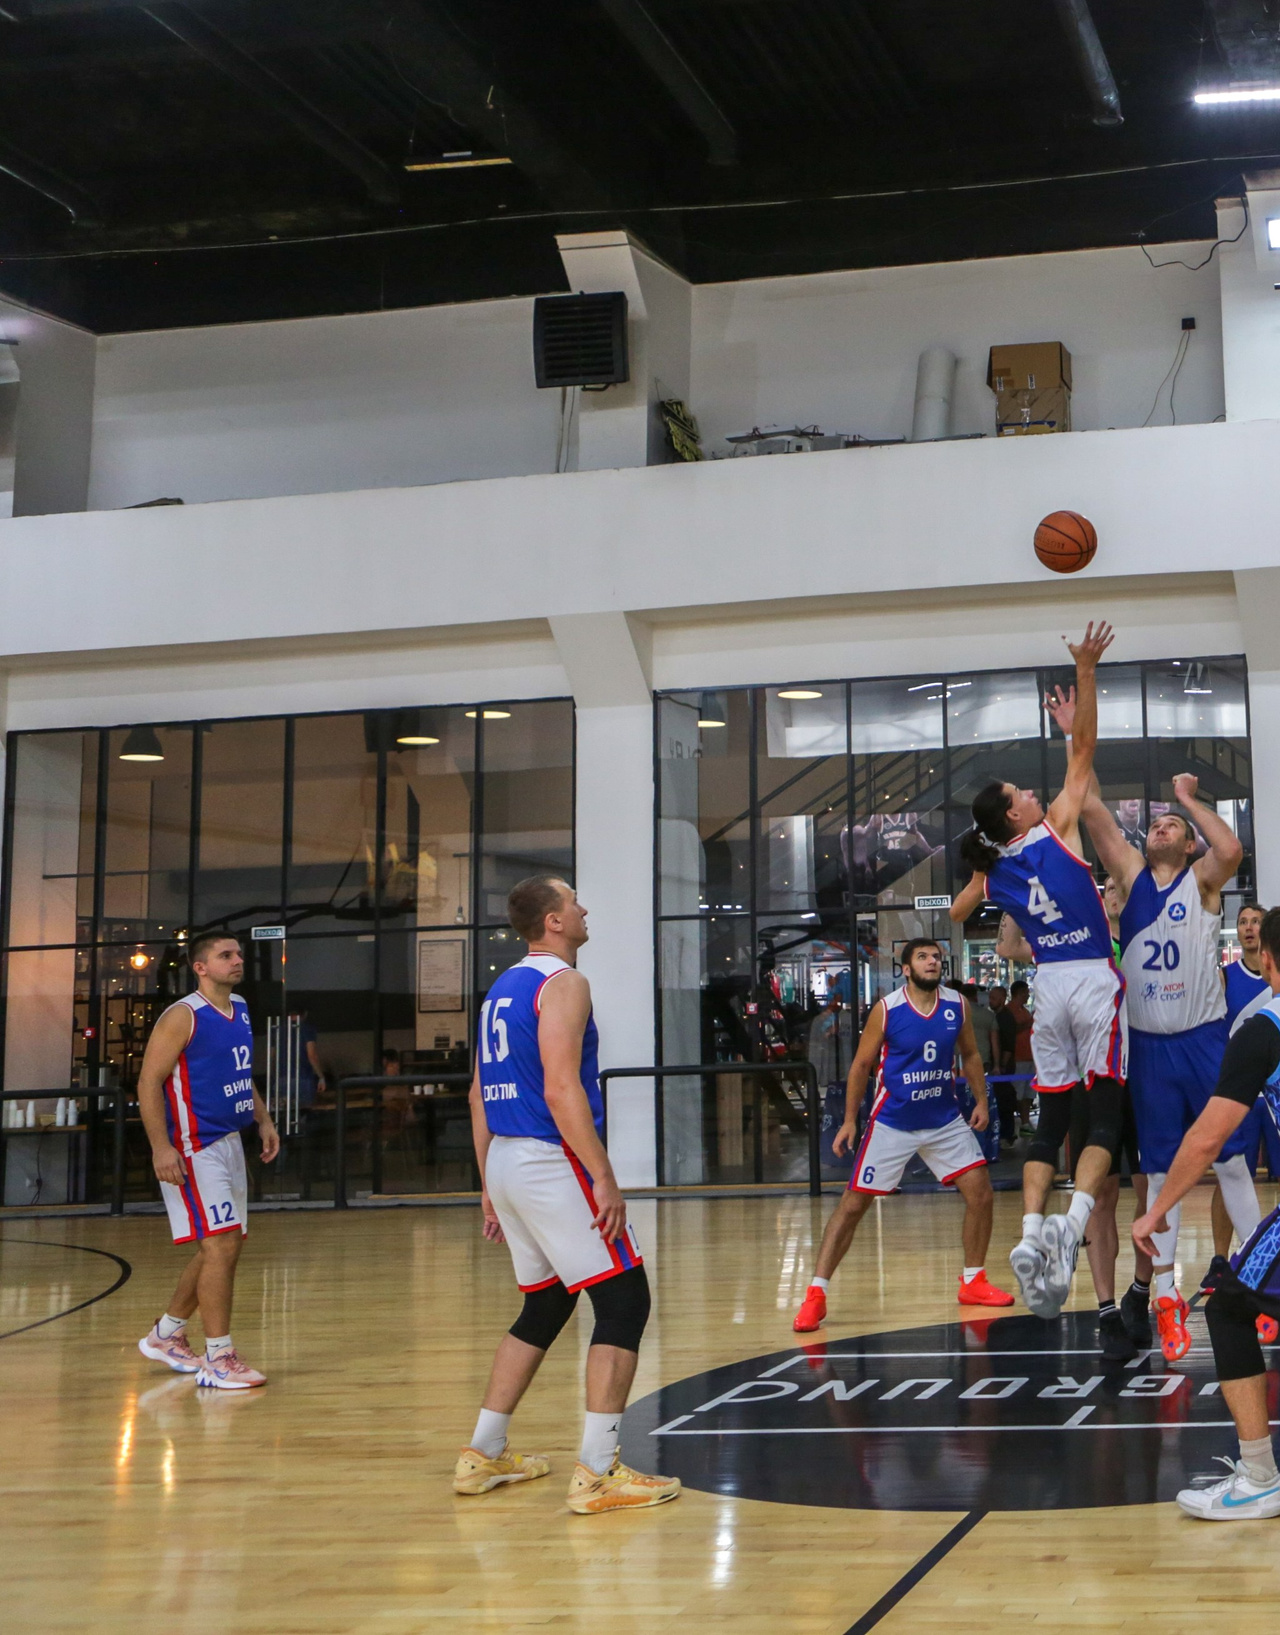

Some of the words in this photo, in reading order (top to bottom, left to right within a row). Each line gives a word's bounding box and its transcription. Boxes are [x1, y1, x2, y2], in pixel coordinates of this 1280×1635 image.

[919, 898, 948, 907] ВЫХОД
[1027, 875, 1064, 925] 4
[1142, 939, 1180, 972] 20
[1160, 991, 1187, 1002] СПОРТ
[1163, 982, 1185, 993] АТОМ
[480, 997, 513, 1064] 15
[232, 1045, 251, 1071] 12
[923, 1040, 937, 1063] 6
[902, 1069, 952, 1085] ВНИИЭФ
[911, 1086, 942, 1101] САРОВ
[862, 1165, 876, 1185] 6
[209, 1201, 235, 1226] 12
